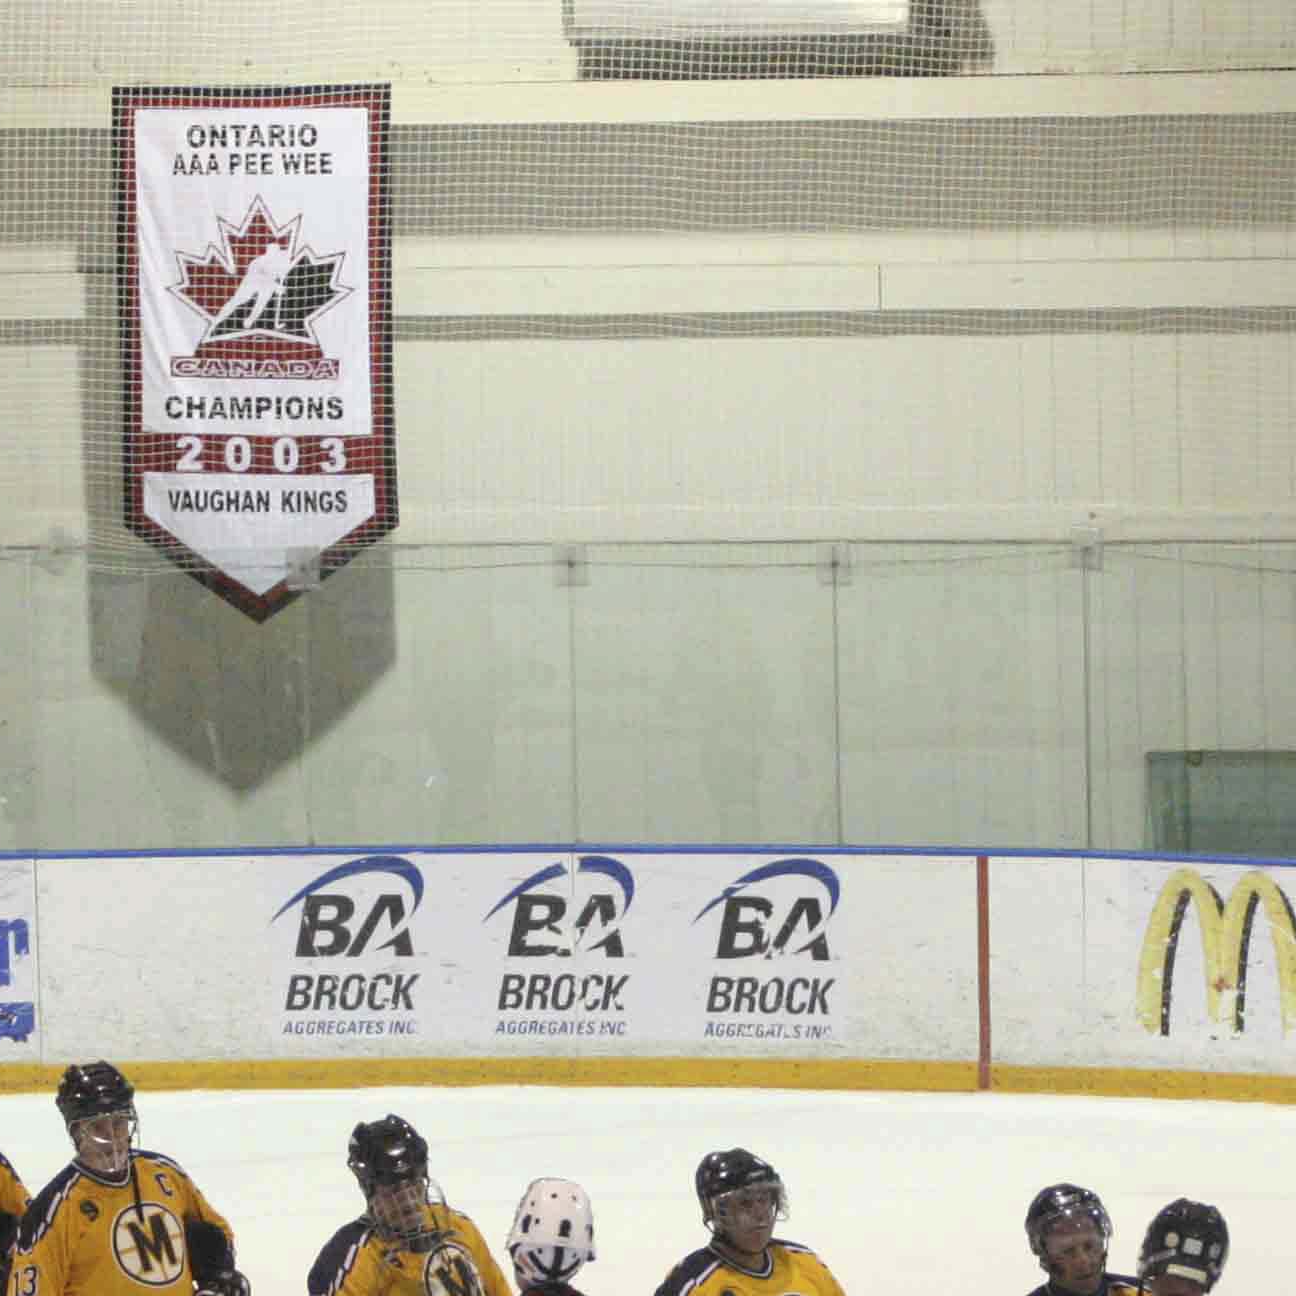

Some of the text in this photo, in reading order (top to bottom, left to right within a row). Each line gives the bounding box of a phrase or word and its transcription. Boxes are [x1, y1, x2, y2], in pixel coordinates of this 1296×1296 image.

[186, 125, 318, 148] ONTARIO
[172, 152, 333, 176] AAA PEE WEE
[175, 358, 339, 378] CANADA
[165, 396, 344, 420] CHAMPIONS
[175, 436, 347, 473] 2003
[168, 489, 348, 513] VAUGHAN KINGS
[295, 893, 414, 957] BA
[507, 893, 624, 957] BA
[715, 895, 831, 960] BA
[285, 972, 419, 1011] BROCK
[498, 972, 630, 1012] BROCK
[706, 976, 836, 1015] BROCK
[283, 1020, 385, 1035] AGGREGATES
[496, 1020, 597, 1035] AGGREGATES
[155, 1172, 174, 1197] C
[126, 1211, 179, 1273] M
